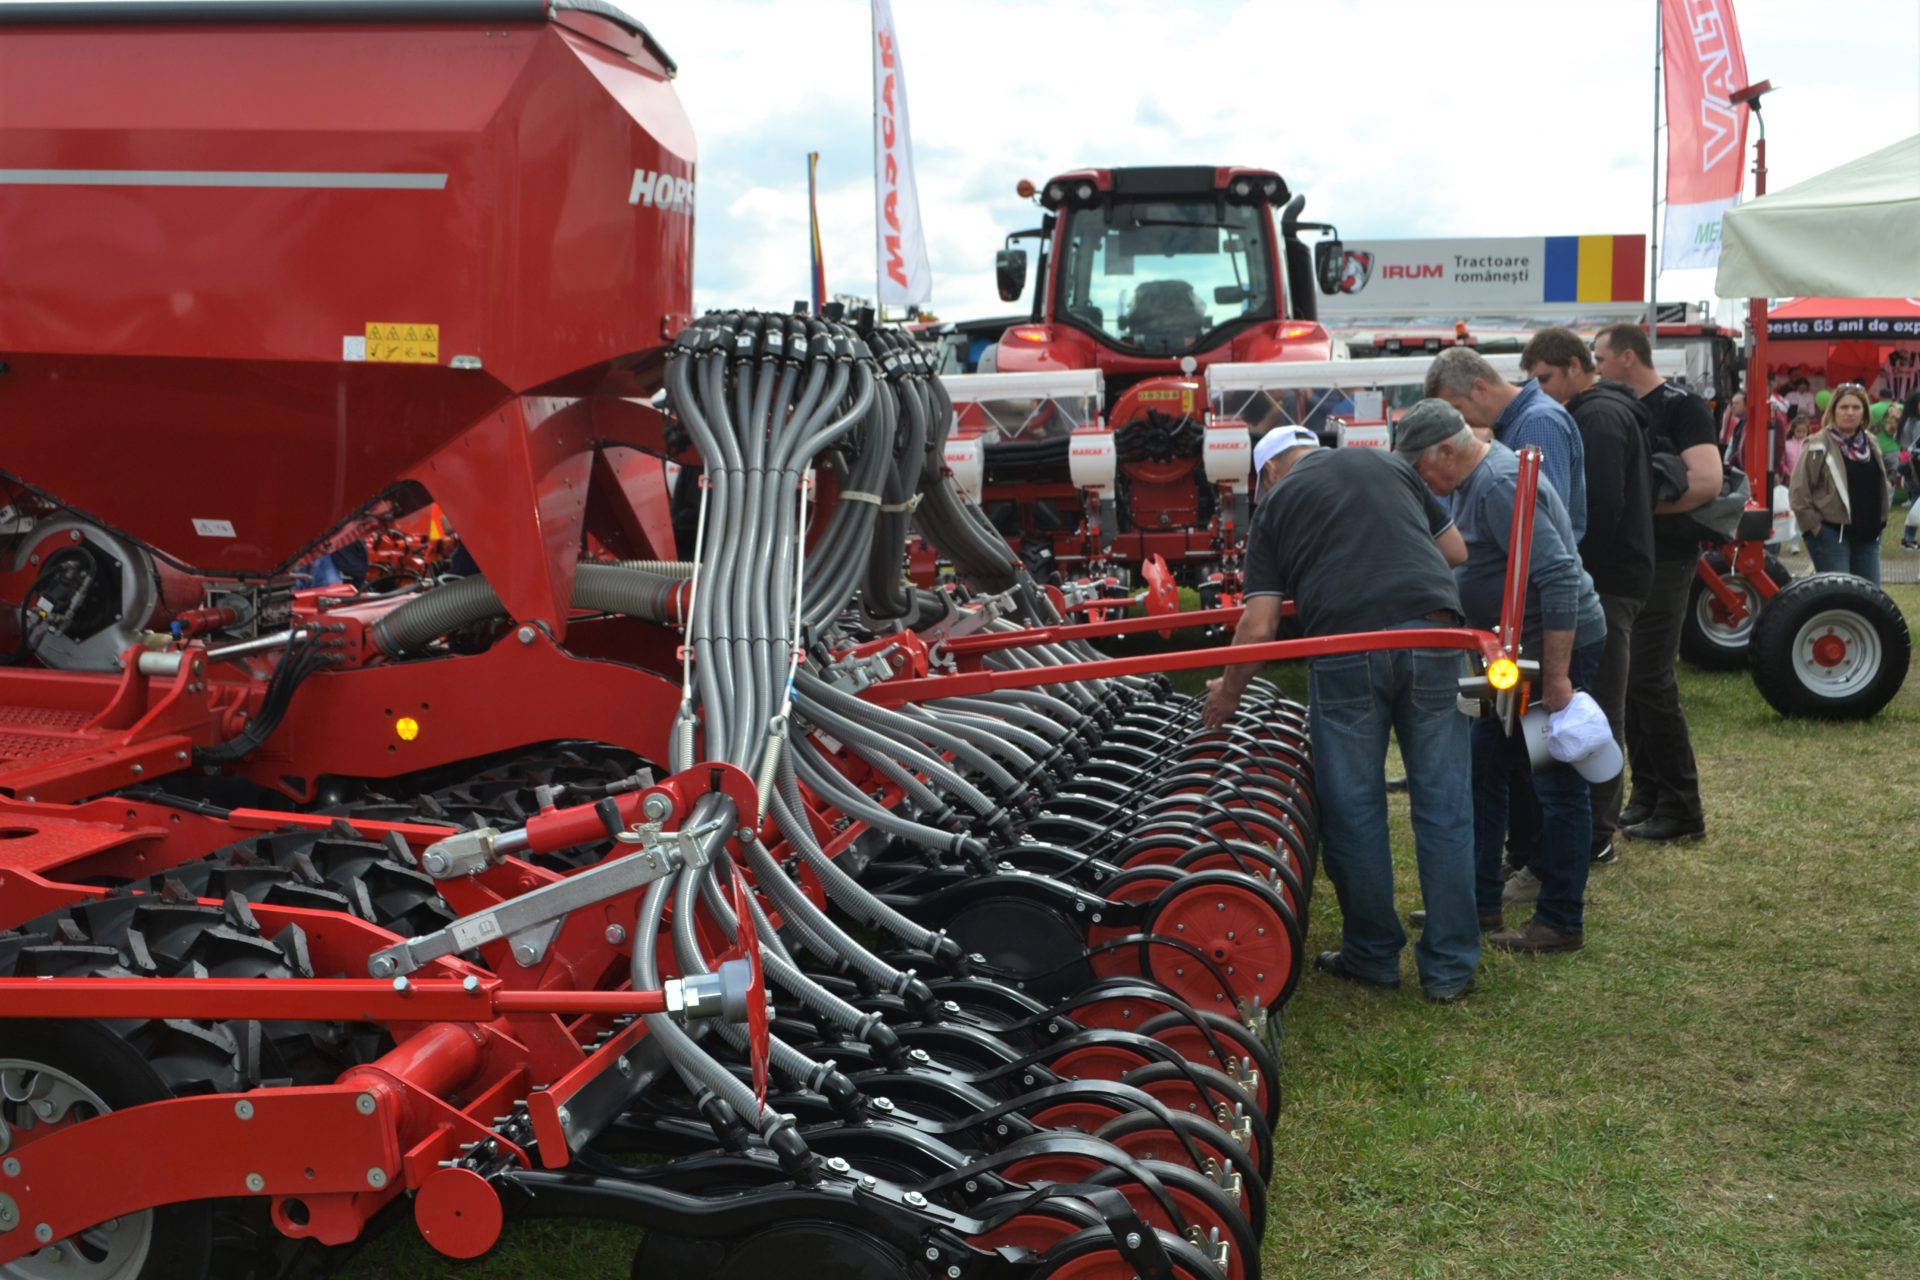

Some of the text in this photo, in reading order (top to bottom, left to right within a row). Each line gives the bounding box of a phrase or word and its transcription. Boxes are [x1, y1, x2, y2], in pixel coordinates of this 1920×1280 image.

[1454, 255, 1530, 269] Tractoare
[1382, 264, 1444, 280] IRUM
[1813, 318, 1834, 333] 65
[1838, 318, 1863, 333] ani
[1868, 317, 1889, 332] de
